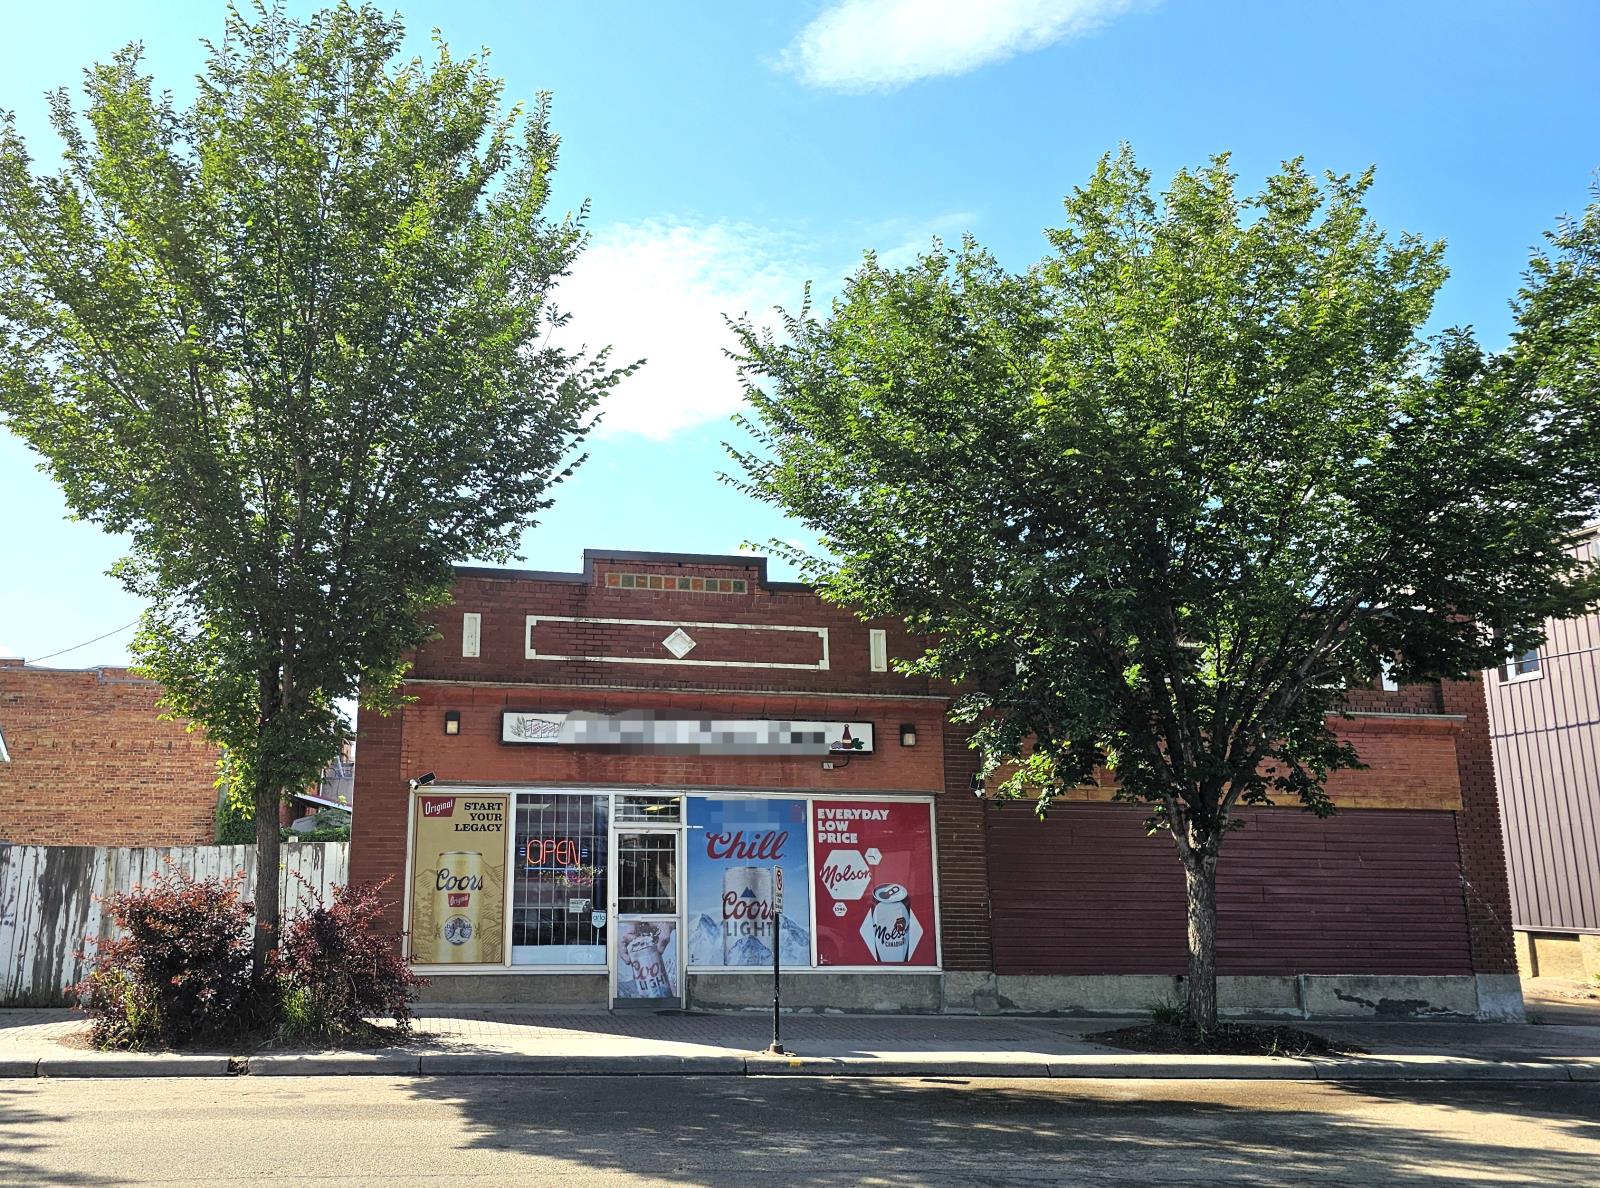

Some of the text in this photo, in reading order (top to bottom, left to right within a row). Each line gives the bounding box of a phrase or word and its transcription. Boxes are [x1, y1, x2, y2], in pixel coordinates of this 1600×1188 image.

[425, 800, 453, 815] Original
[464, 802, 503, 811] START
[817, 808, 890, 820] EVERYDAY
[470, 812, 503, 821] YOUR
[454, 823, 503, 832] LEGACY
[817, 820, 849, 831] LOW
[705, 830, 789, 860] Chill
[818, 832, 858, 844] PRICE
[527, 839, 581, 864] OPEN
[436, 868, 484, 891] Coors
[820, 864, 872, 889] Molson
[722, 891, 775, 920] Coors
[726, 921, 773, 937] LIGHT
